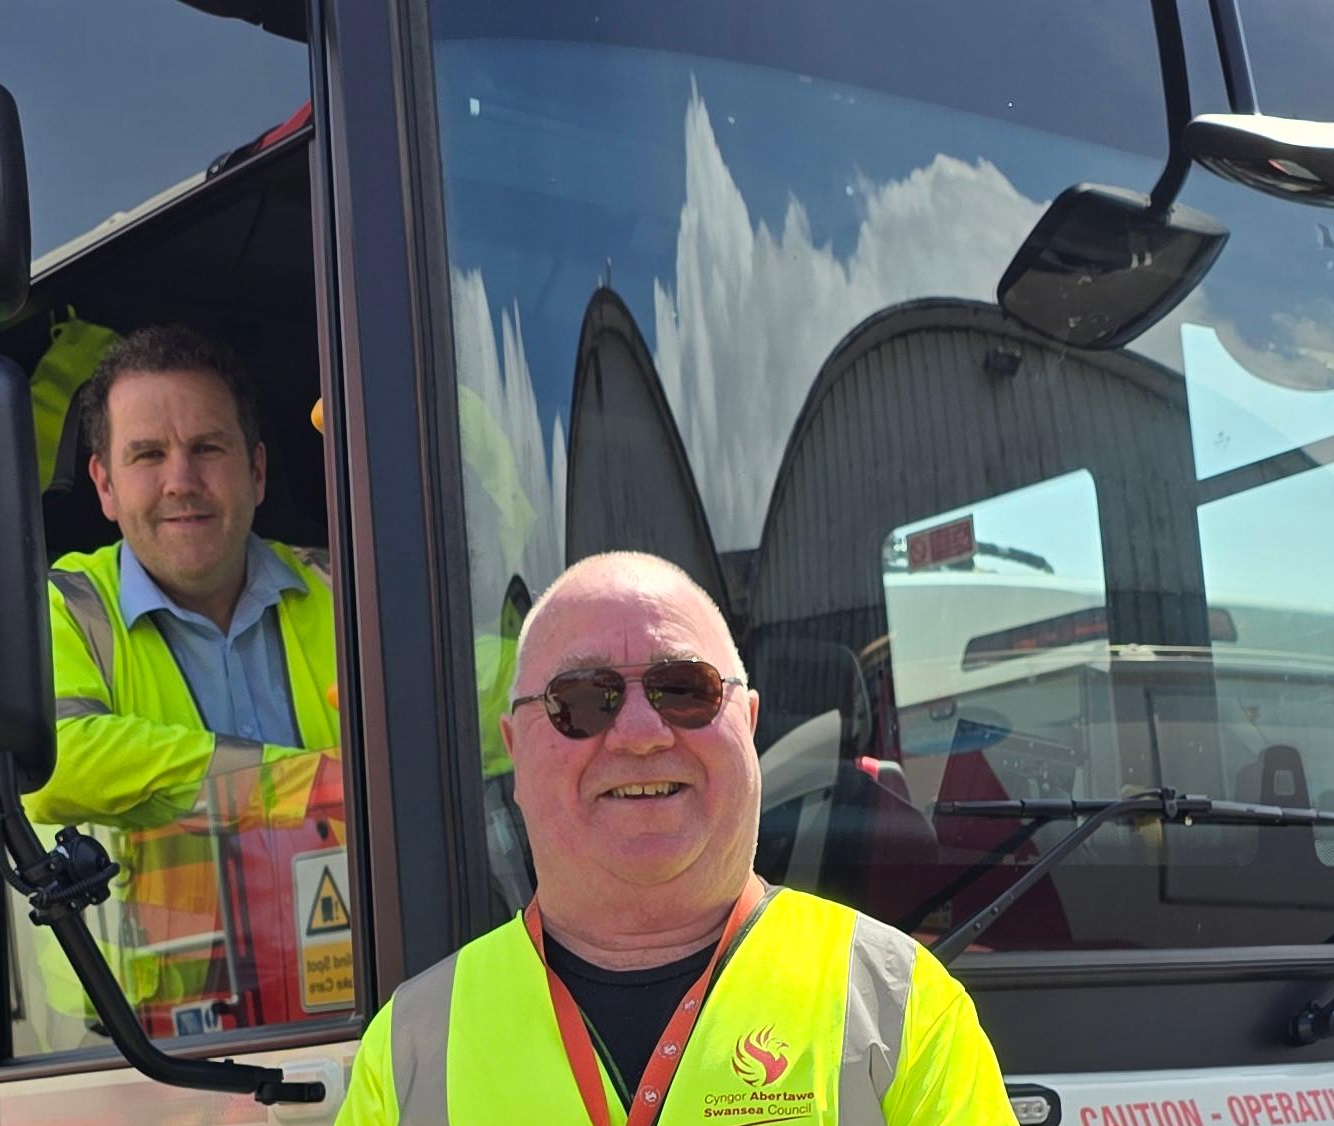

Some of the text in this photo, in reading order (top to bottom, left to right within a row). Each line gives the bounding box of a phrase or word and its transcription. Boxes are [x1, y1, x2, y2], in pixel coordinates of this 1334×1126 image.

[704, 1091, 815, 1106] Cyngor Abertawe
[704, 1103, 812, 1118] Swansea Council
[1211, 1112, 1222, 1121] -
